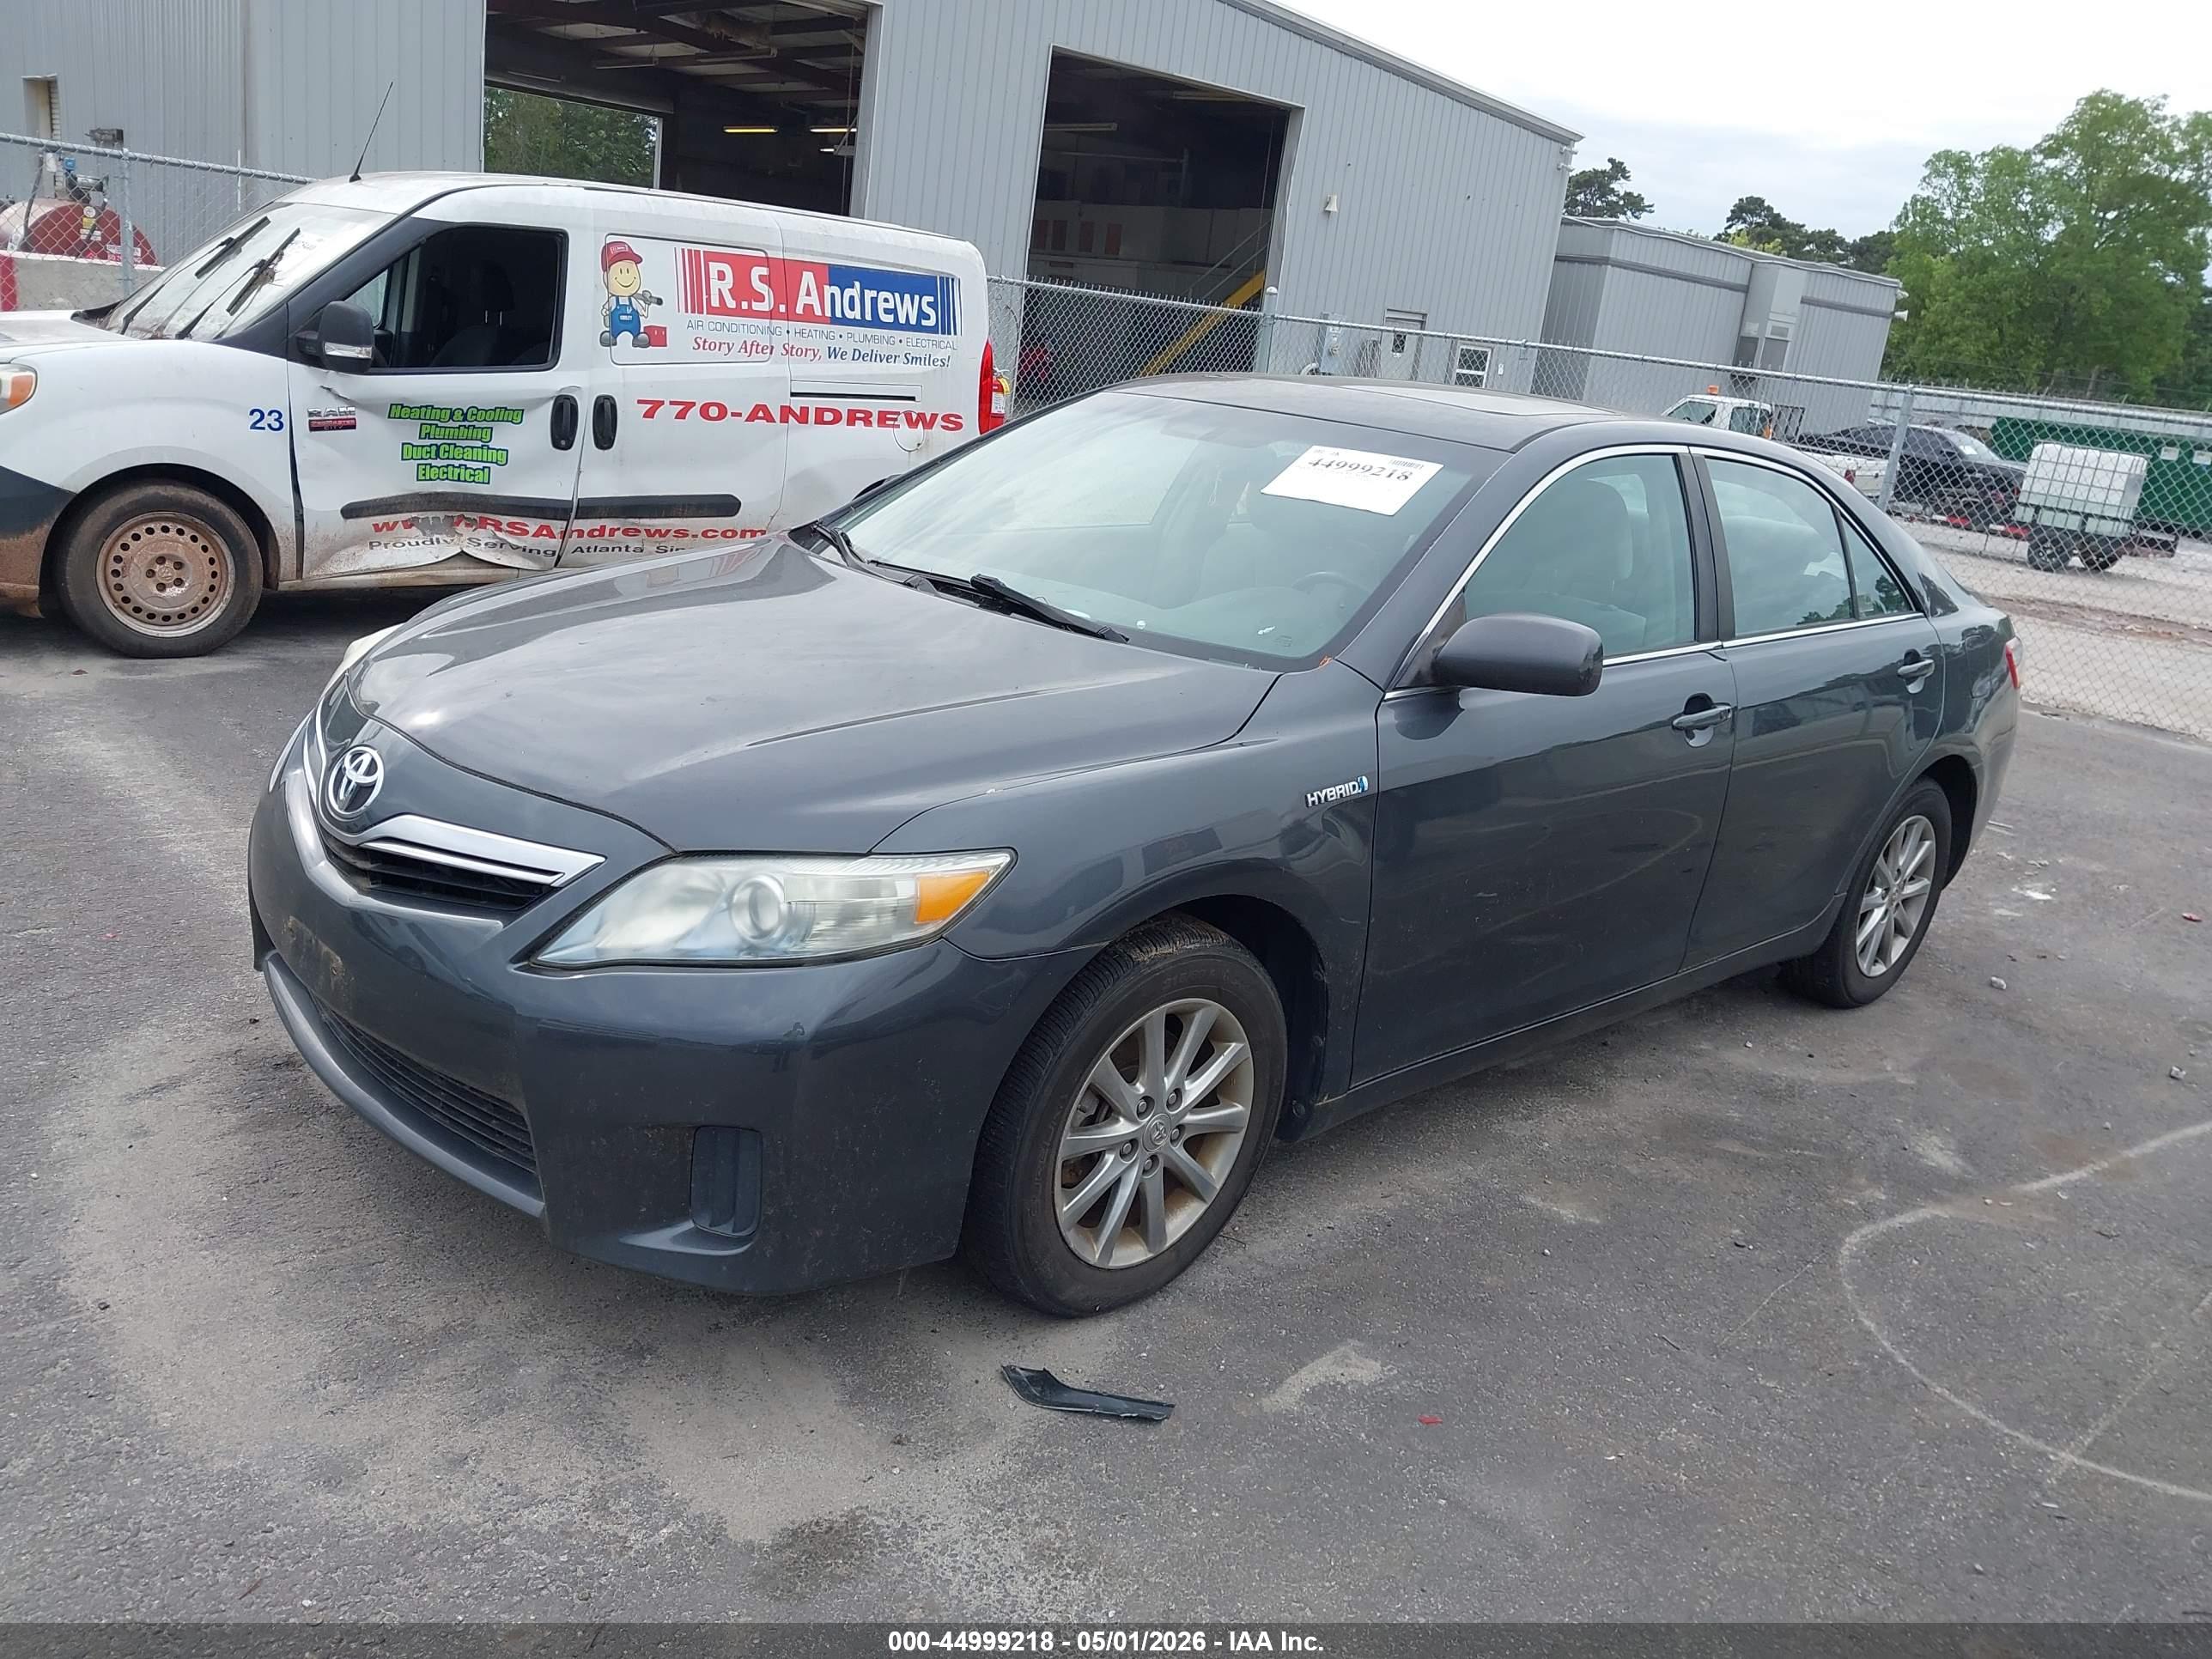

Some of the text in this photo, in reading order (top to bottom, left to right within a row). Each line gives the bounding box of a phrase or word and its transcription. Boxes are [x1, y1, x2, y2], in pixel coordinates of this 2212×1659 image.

[708, 261, 937, 326] R.S. Andrews
[687, 319, 957, 350] AIR CONDITIONING HEATING PLUMBING ELECTRICAL
[692, 336, 951, 368] Story After Story, We Deliver Smiles!
[249, 408, 284, 431] 23
[307, 406, 356, 417] RAM
[388, 404, 525, 424] Heating & Cooling
[636, 398, 964, 432] 770-ANDREWS
[418, 423, 493, 443] Plumbing
[401, 442, 508, 466] Duct Cleaning
[416, 464, 490, 484] Electrical
[1308, 458, 1413, 481] 44999218
[466, 537, 557, 557] Serving
[571, 544, 643, 555] Atlanta
[1306, 781, 1360, 807] HYBRID
